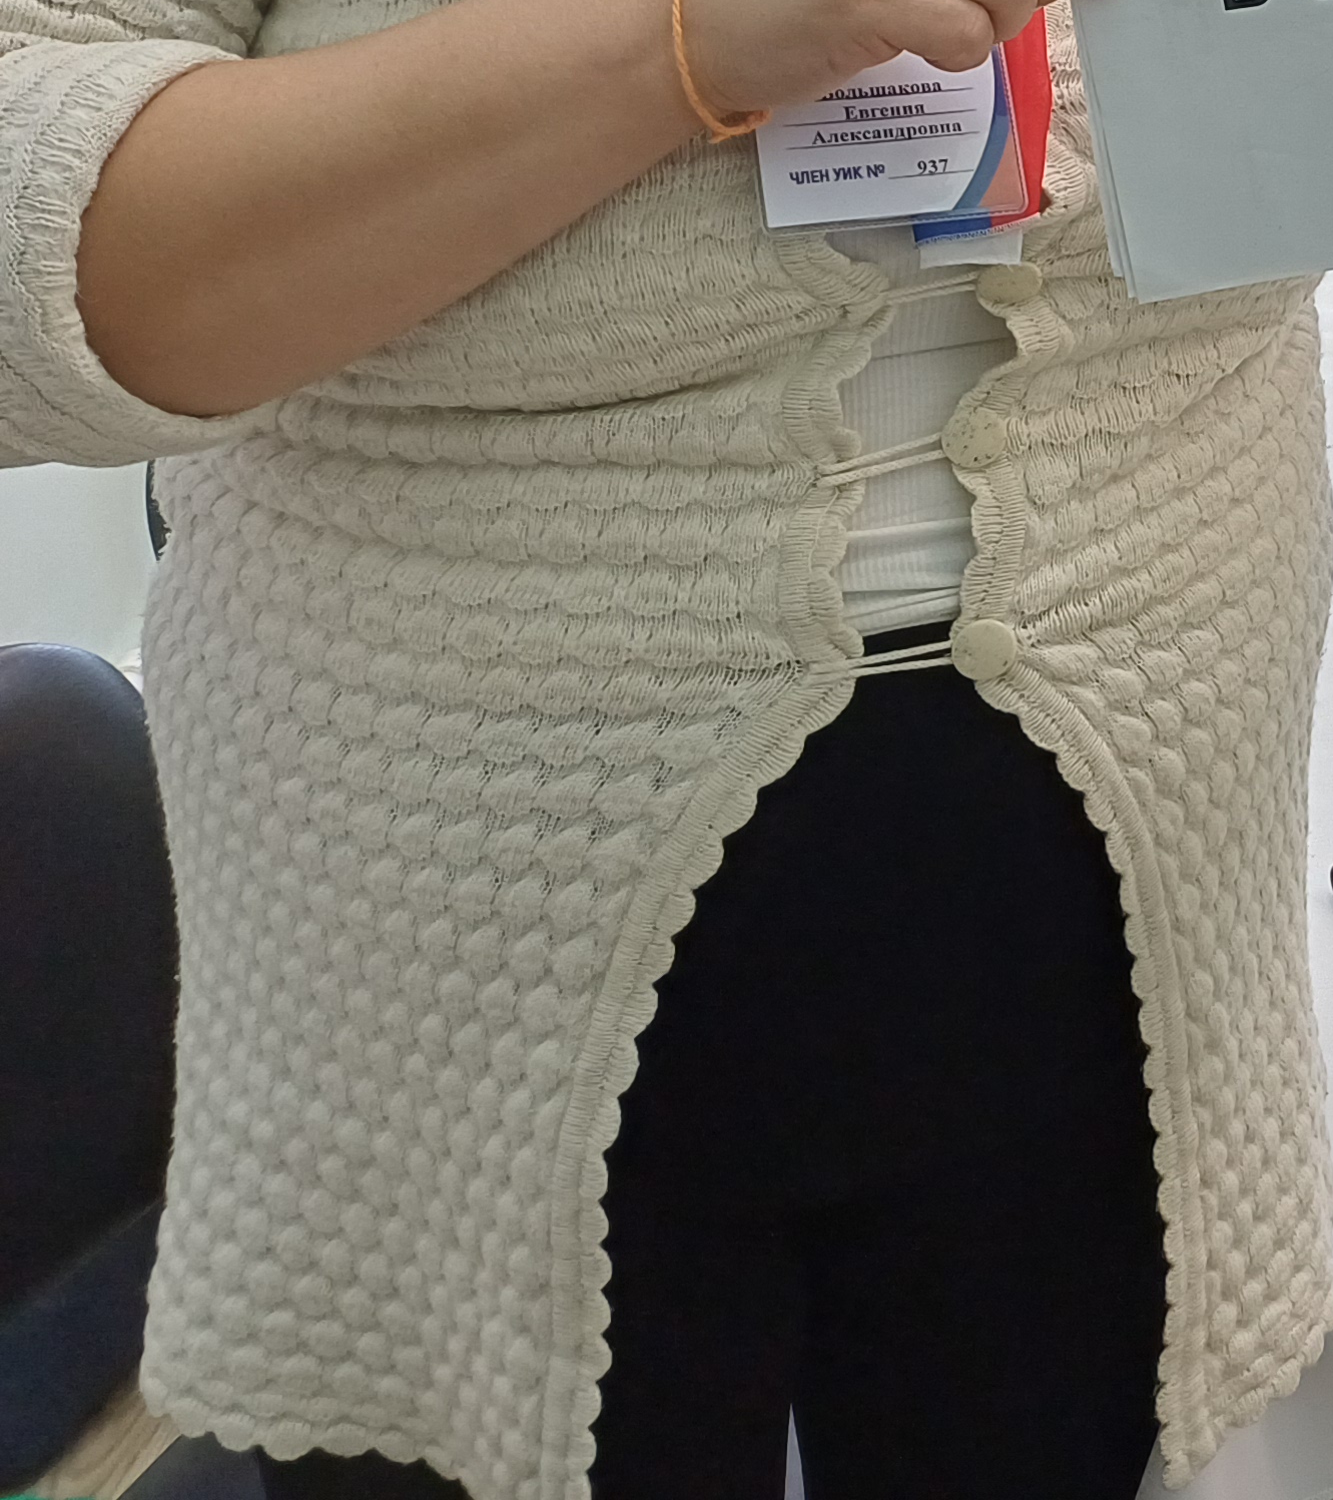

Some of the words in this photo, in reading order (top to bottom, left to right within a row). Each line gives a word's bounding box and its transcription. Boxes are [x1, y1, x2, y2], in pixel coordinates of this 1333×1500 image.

[843, 103, 926, 121] Евгения
[811, 122, 962, 146] Александровна
[789, 167, 830, 185] ЧЛЕН
[833, 165, 864, 182] УИК
[867, 163, 885, 178] №
[917, 158, 949, 176] 937
